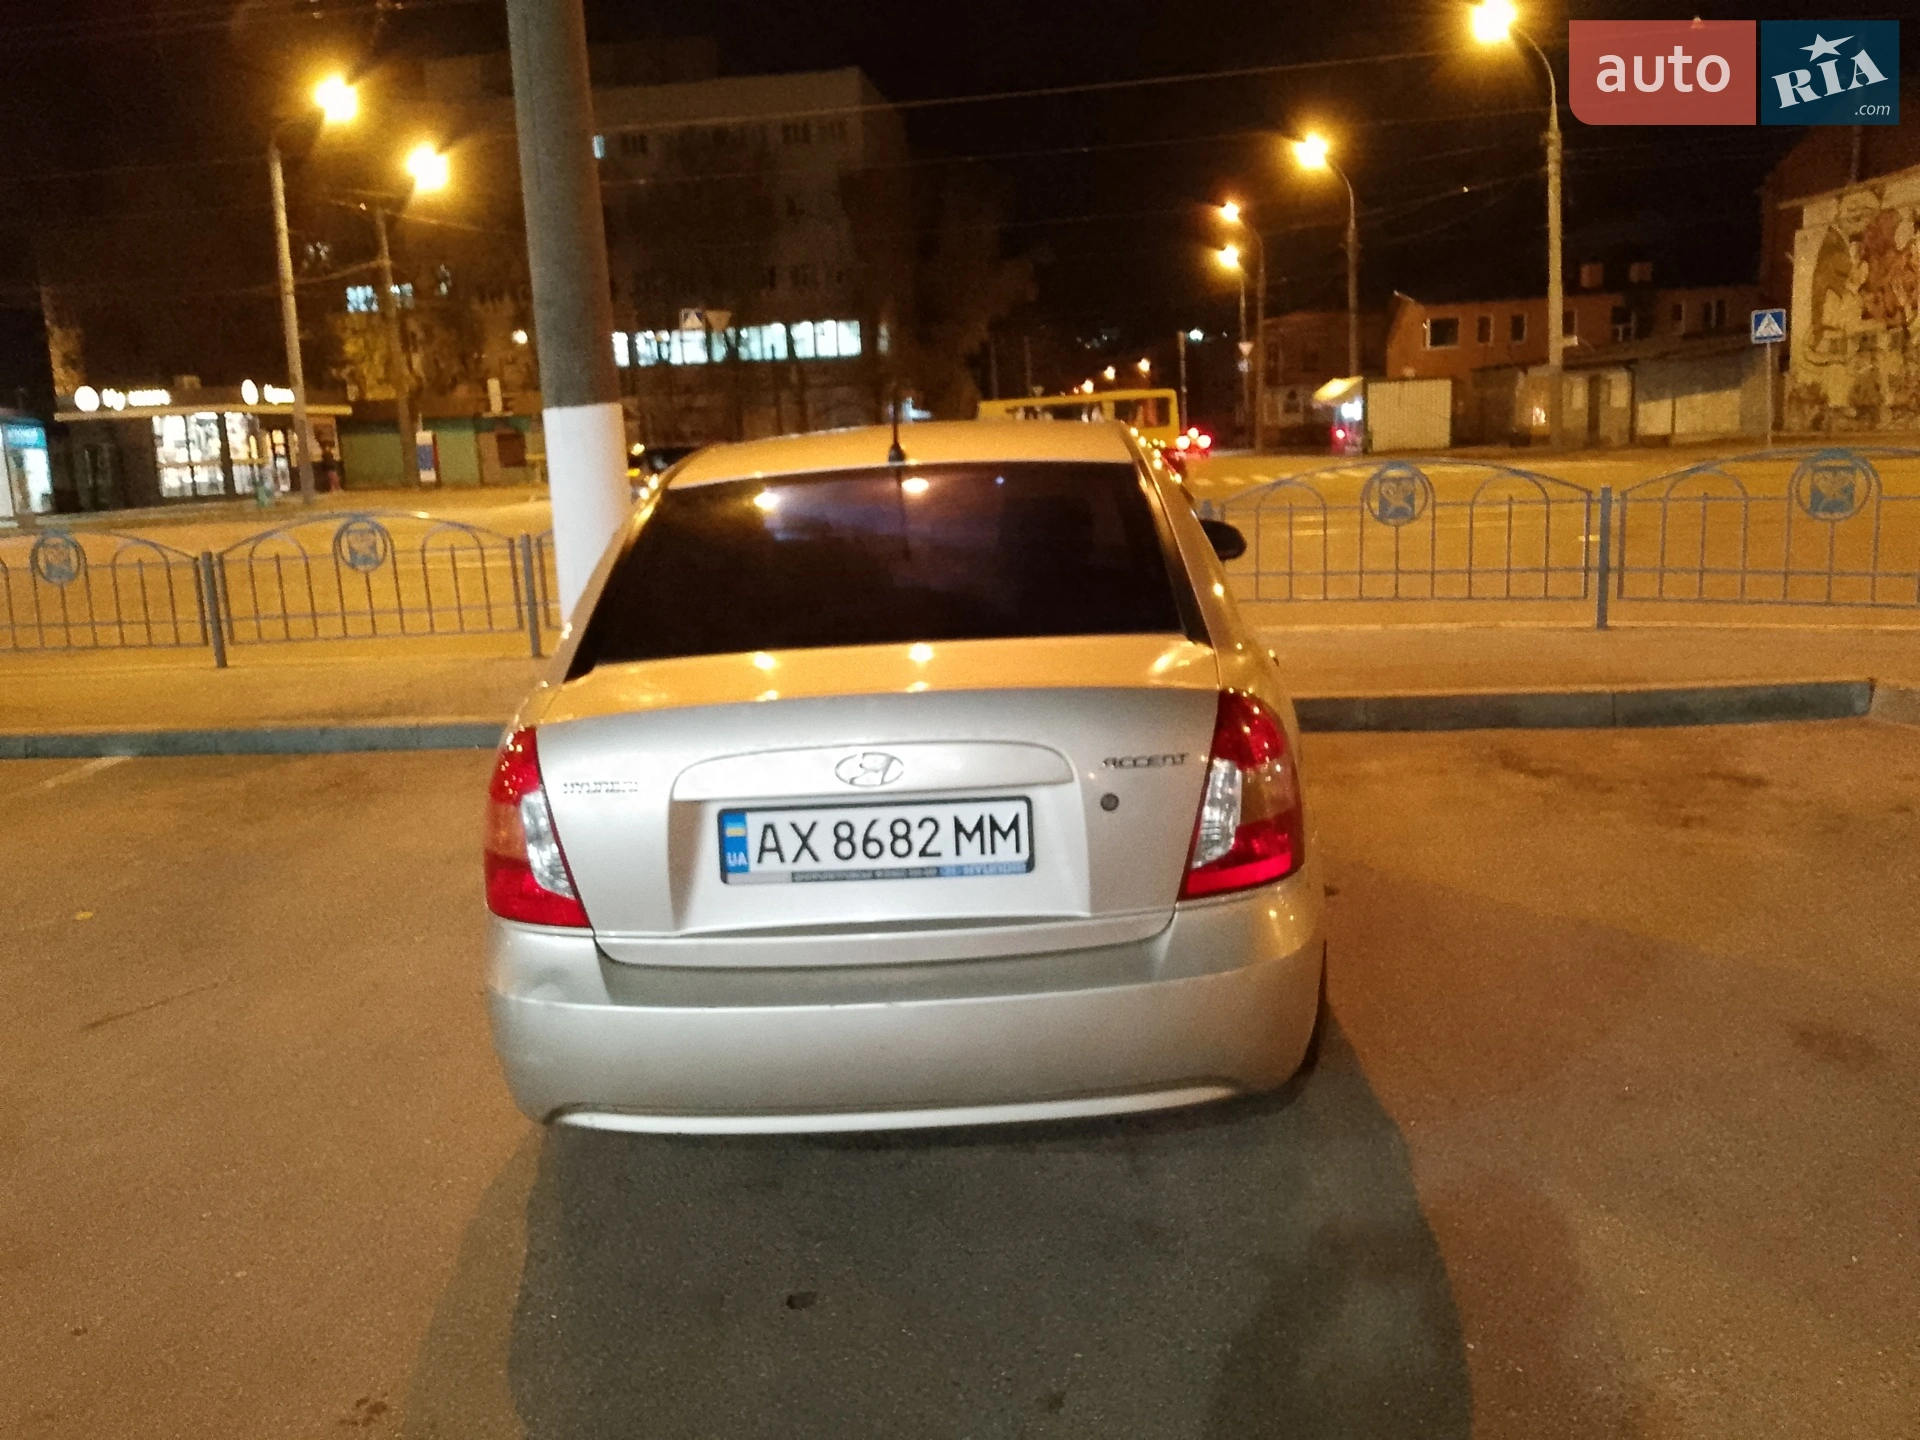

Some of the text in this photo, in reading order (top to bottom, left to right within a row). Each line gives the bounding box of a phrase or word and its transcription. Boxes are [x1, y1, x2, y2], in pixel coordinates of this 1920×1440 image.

[1103, 752, 1189, 770] ACCENT
[756, 812, 1021, 864] AX 8682 MM
[726, 851, 748, 867] UA
